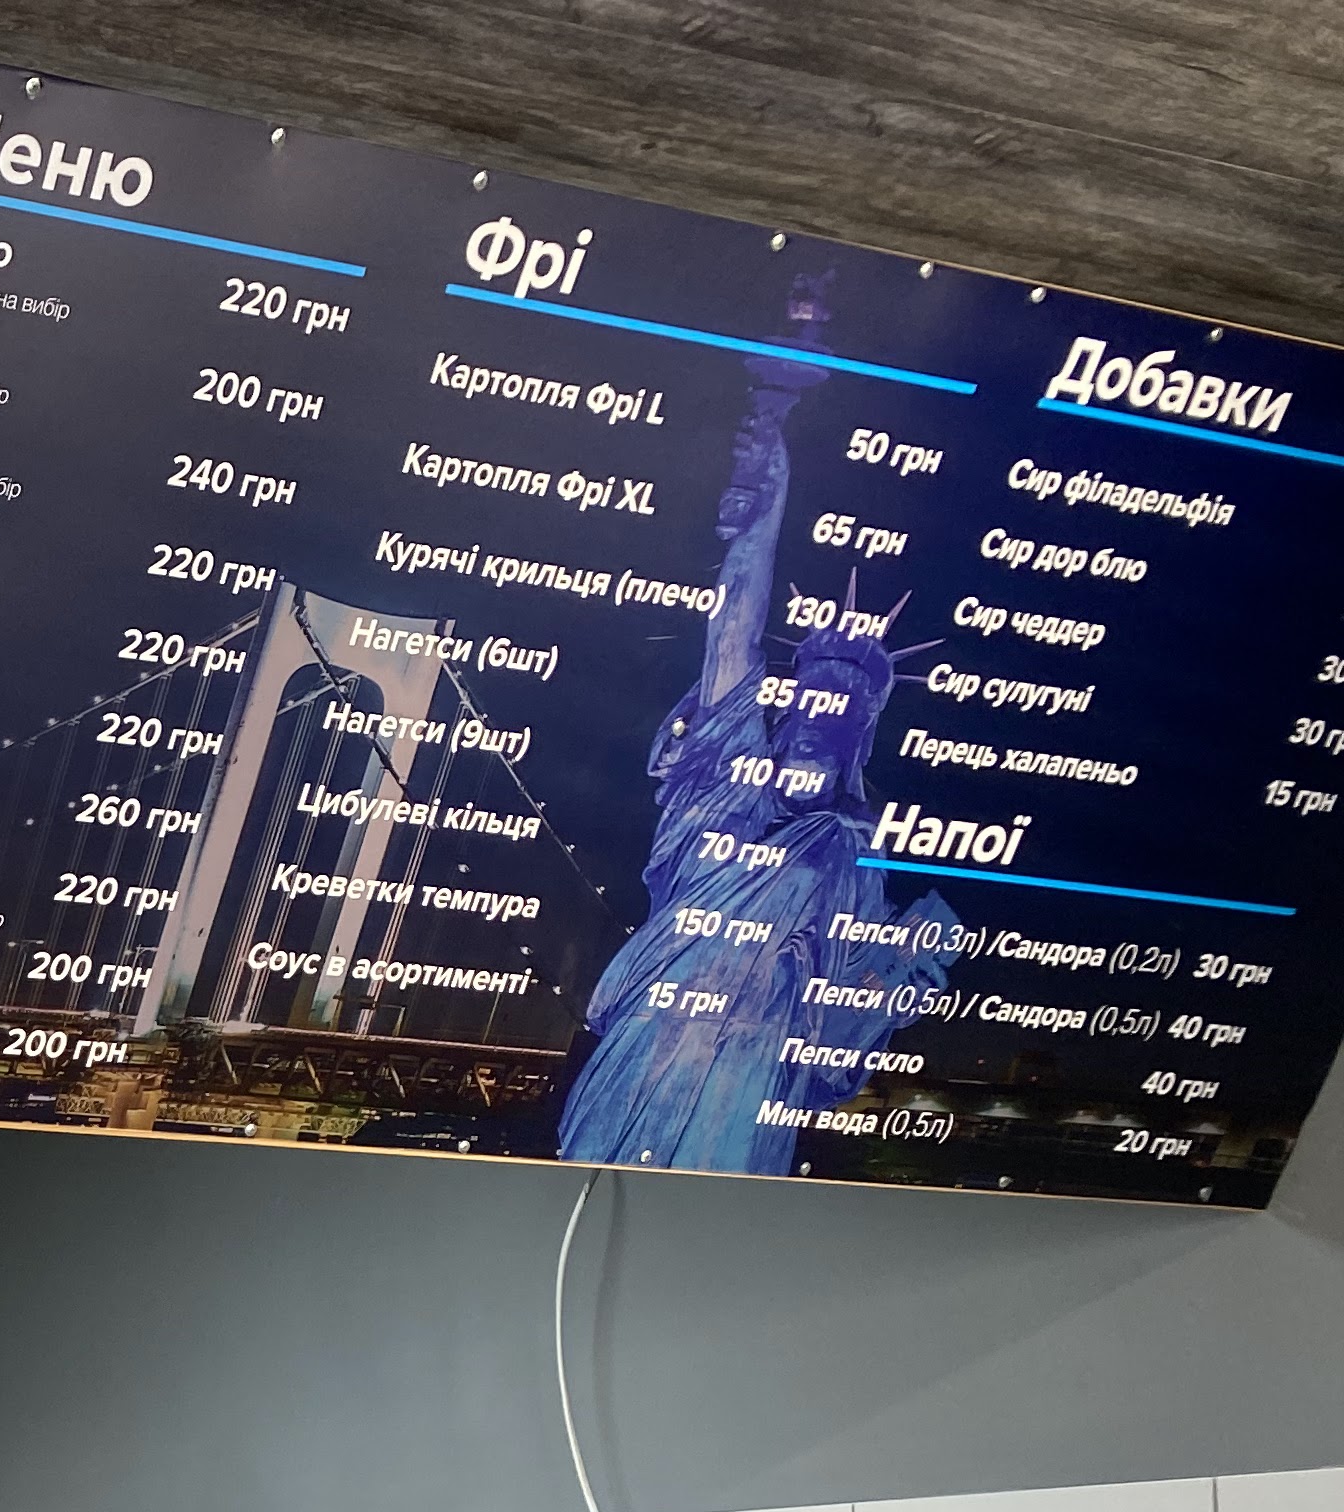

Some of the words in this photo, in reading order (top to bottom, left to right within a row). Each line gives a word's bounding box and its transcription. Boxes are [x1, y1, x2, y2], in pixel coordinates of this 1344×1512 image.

[466, 217, 592, 298] Фрі
[22, 298, 69, 322] вибір
[430, 353, 580, 408] Картопля
[587, 383, 645, 424] Фрі
[646, 393, 663, 424] L
[1045, 337, 1293, 432] Добавки
[847, 429, 889, 463] 50
[890, 444, 943, 476] грн
[1009, 459, 1062, 500] Сир
[1064, 470, 1235, 527] філадельфія
[349, 617, 473, 663] Нагетси
[478, 636, 557, 681] (6шт)
[927, 664, 980, 701] Сир
[983, 678, 1095, 715] сулугуні
[900, 729, 997, 769] Перець
[1000, 749, 1138, 785] халапеньо
[298, 783, 440, 826] Цибулеві
[443, 803, 541, 840] кільця
[1266, 780, 1296, 805] 15
[1293, 790, 1337, 815] грн
[870, 802, 1031, 865] Напої
[248, 943, 321, 978] Соус
[326, 956, 346, 976] в
[353, 959, 531, 994] асортименті
[827, 913, 910, 946] Пепси
[912, 920, 986, 959] (0,3л)
[986, 931, 1106, 970] /Сандора
[1110, 943, 1180, 979] (0,2л)
[1193, 954, 1228, 979] 30
[1229, 964, 1272, 987] грн
[3, 1029, 67, 1058] 200
[73, 1041, 127, 1067] грн
[756, 1100, 812, 1127] Мин
[815, 1111, 878, 1135] вода
[883, 1109, 953, 1143] (0,5л)
